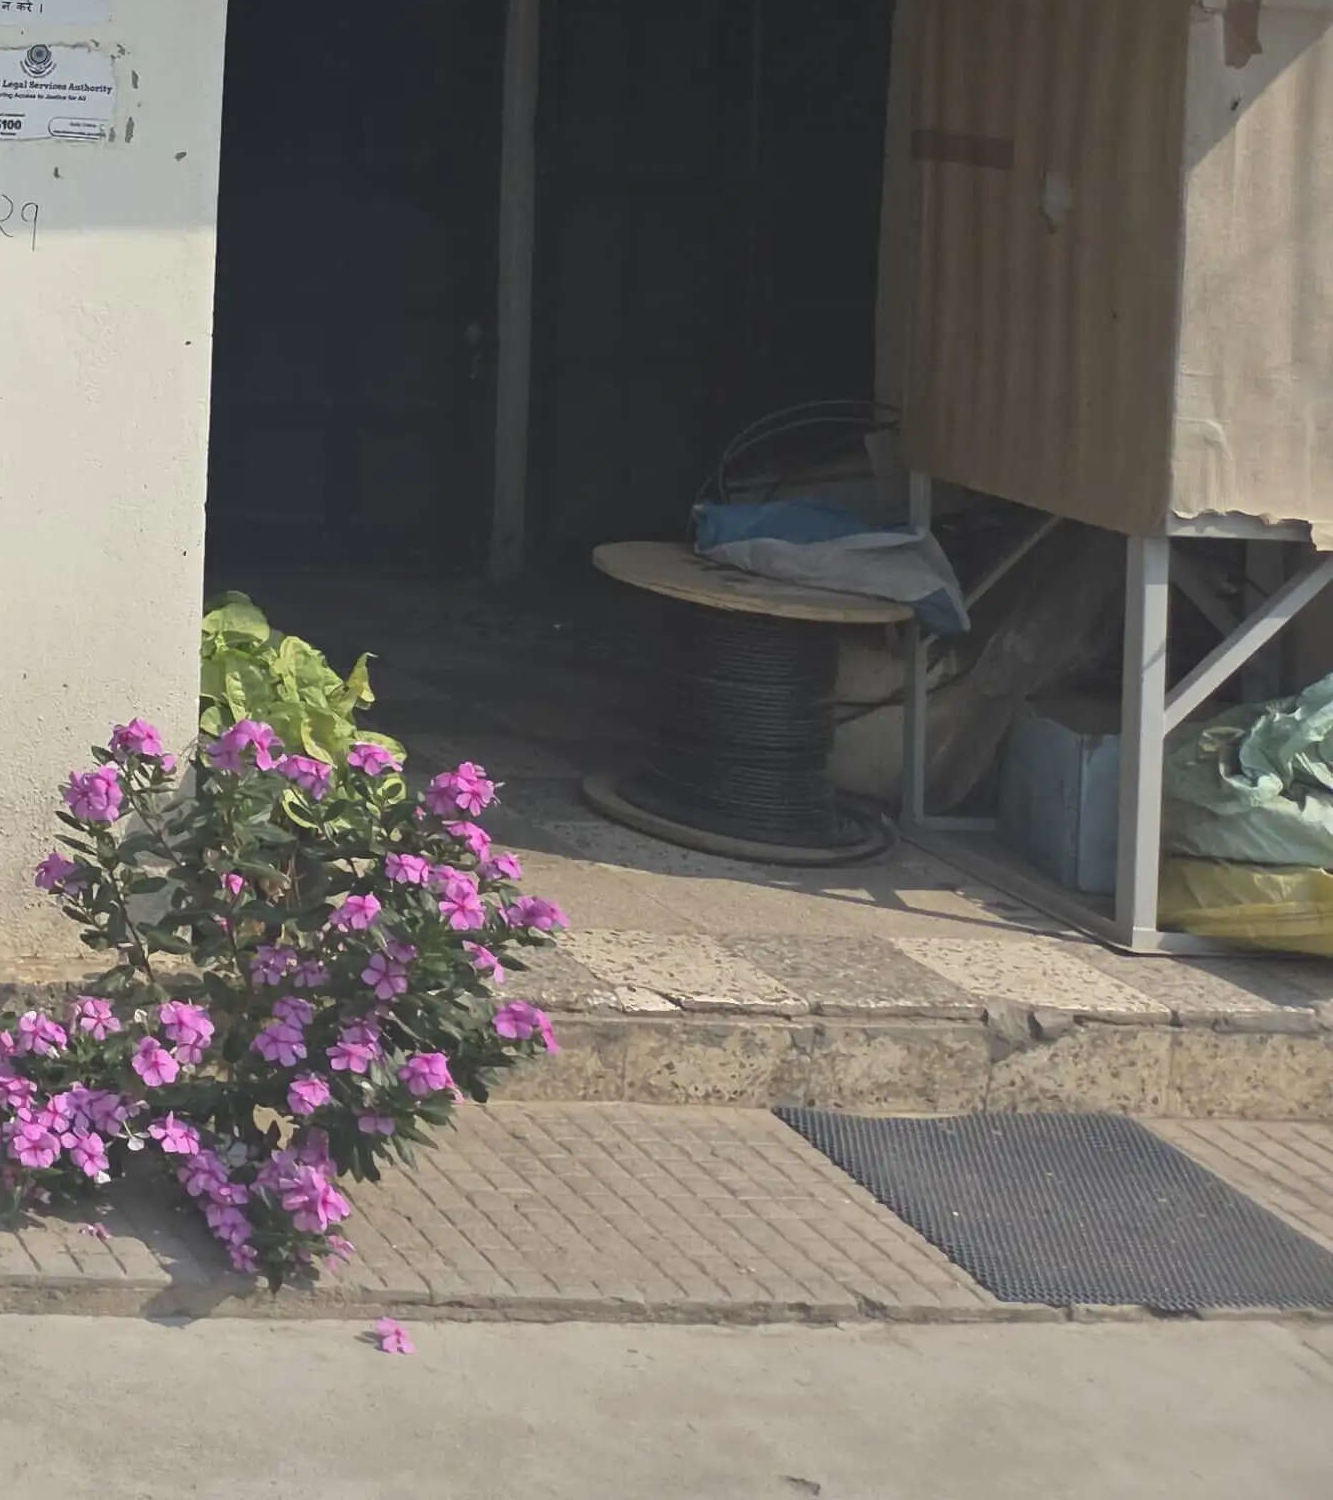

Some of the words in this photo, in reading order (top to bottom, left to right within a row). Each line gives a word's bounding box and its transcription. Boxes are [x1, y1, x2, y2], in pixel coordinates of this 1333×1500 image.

[1, 1, 13, 11] न
[2, 80, 27, 90] Legal
[29, 81, 66, 90] Services
[68, 82, 112, 94] Authority
